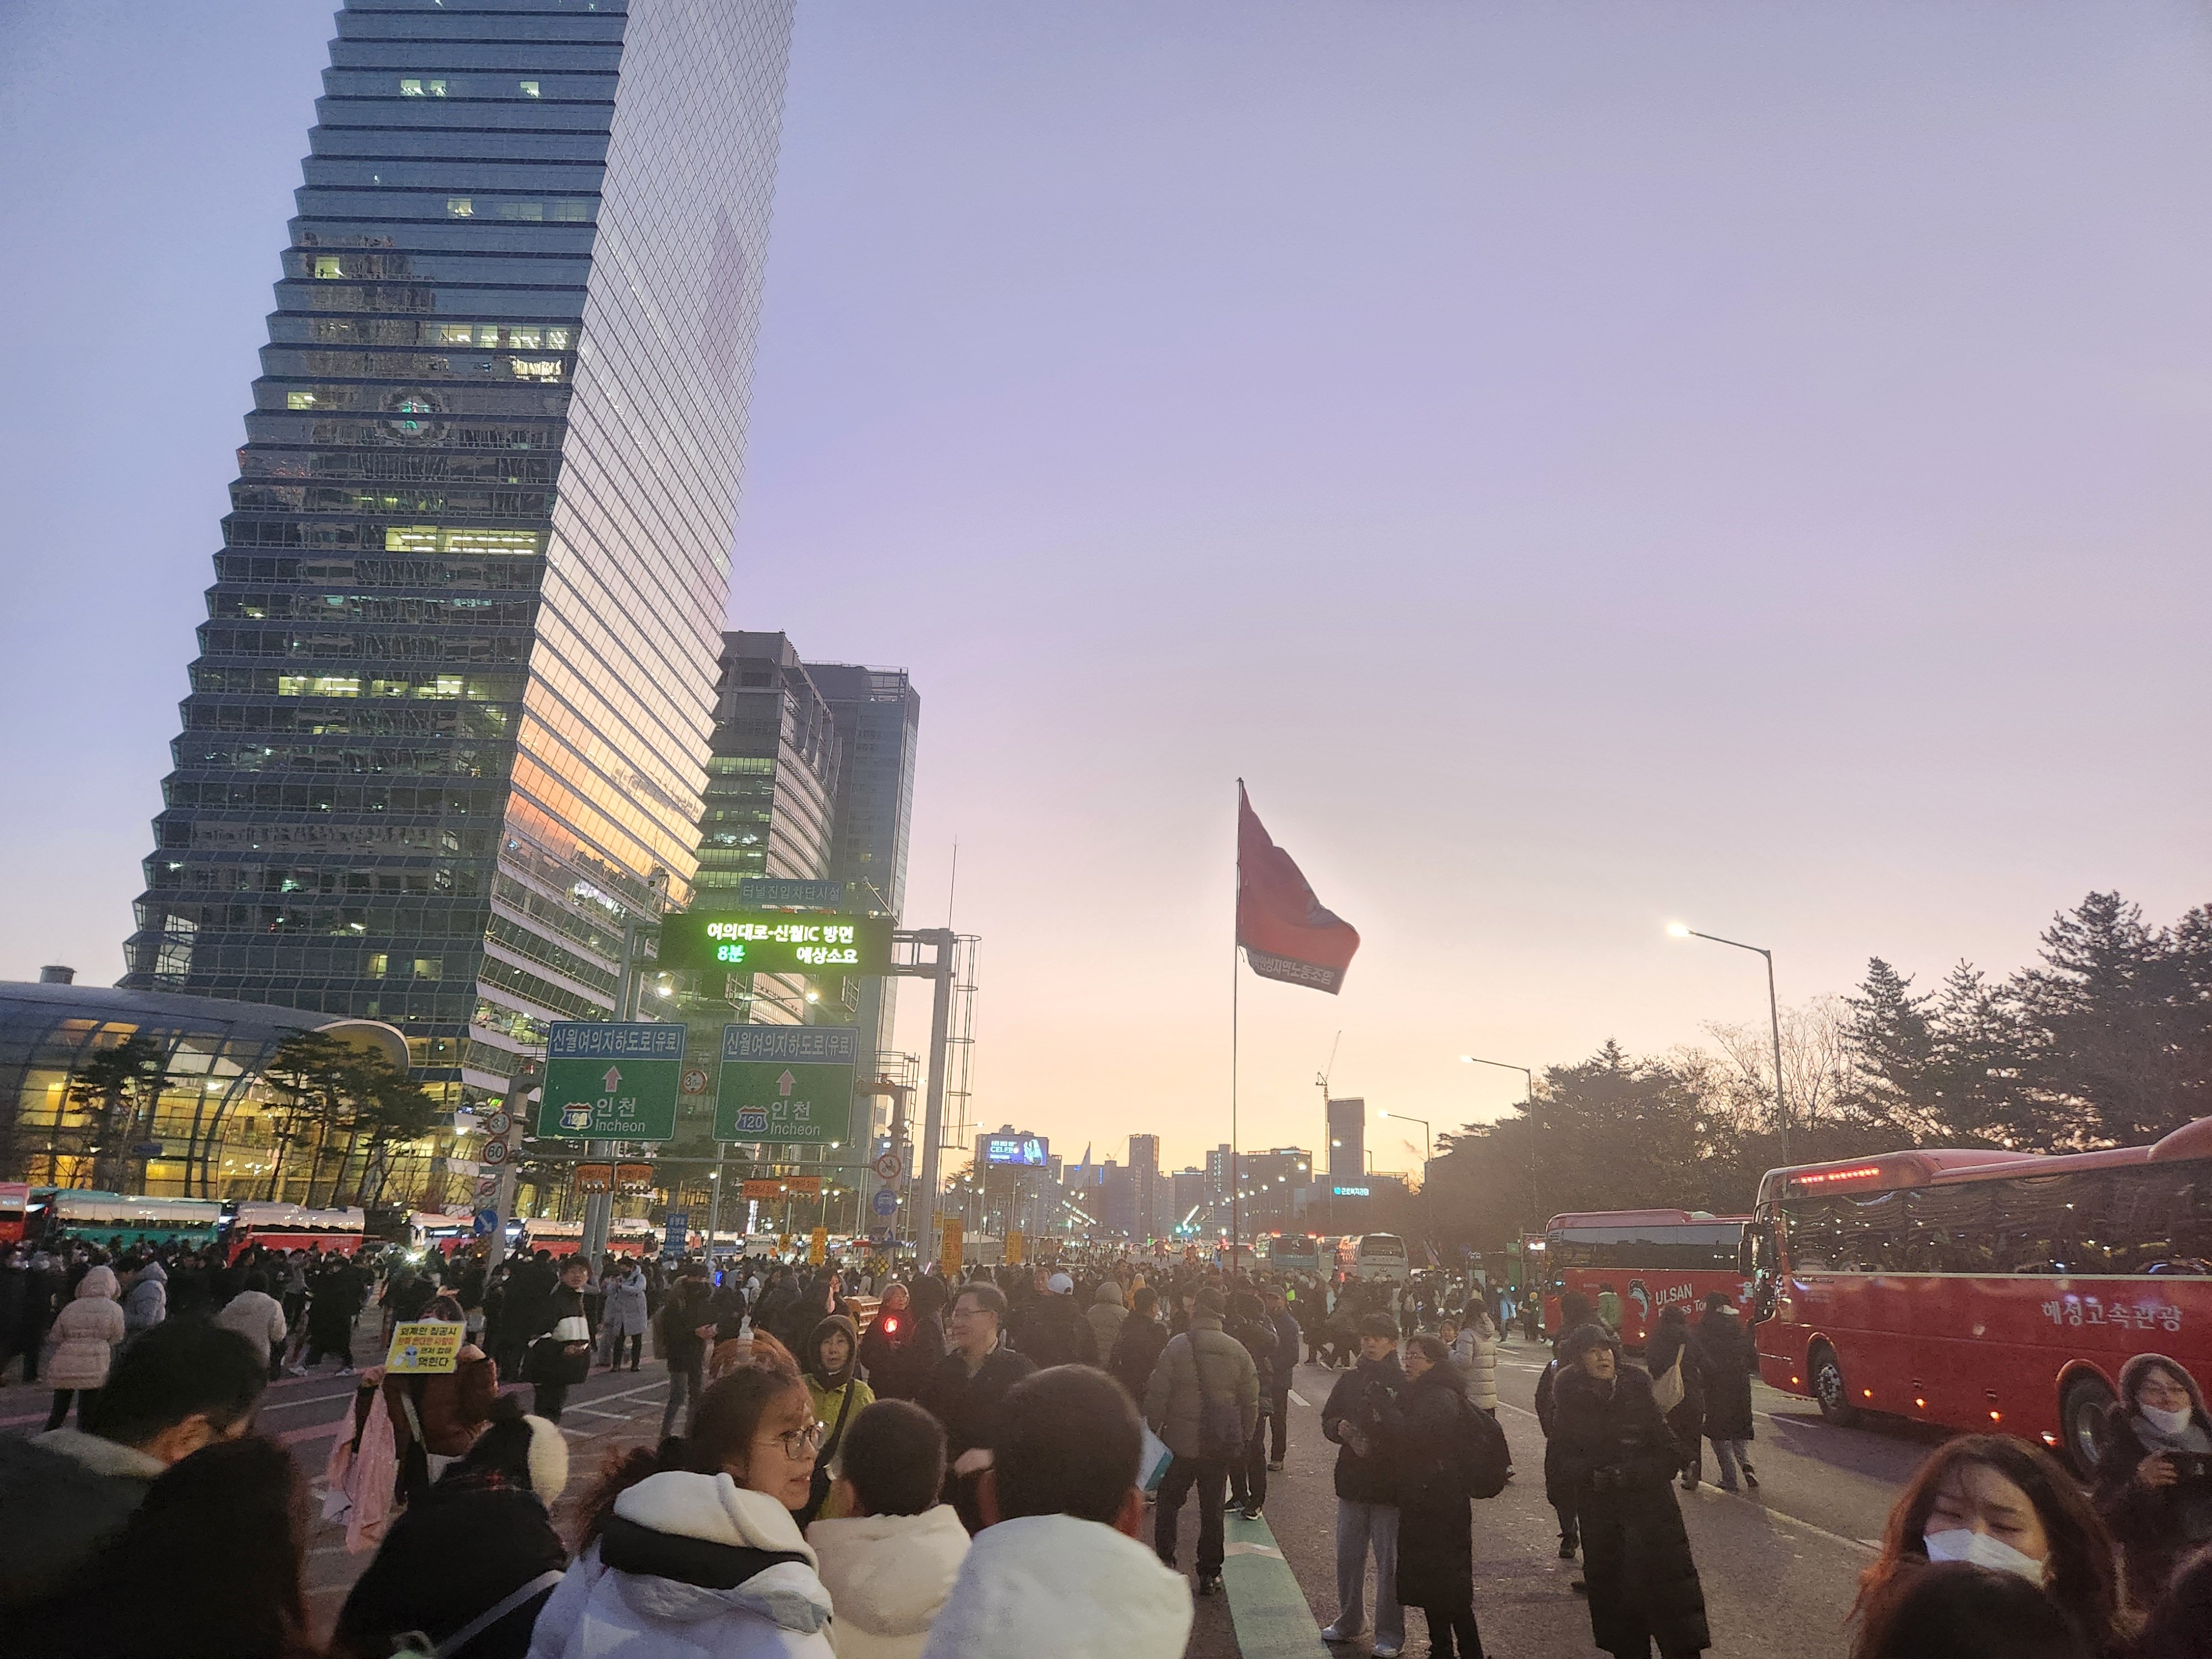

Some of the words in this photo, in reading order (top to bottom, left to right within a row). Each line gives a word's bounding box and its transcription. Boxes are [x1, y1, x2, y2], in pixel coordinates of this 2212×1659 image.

[743, 884, 840, 901] 터널진입차단시설
[823, 925, 854, 944] 방면
[717, 945, 745, 963] 8분
[796, 946, 859, 964] 예상소요
[553, 1028, 680, 1053] 신월여의지하도로(유료)
[726, 1031, 853, 1057] 신월여의지하도로(유료)
[596, 1097, 636, 1118] 인천
[771, 1100, 811, 1121] 인천
[595, 1119, 646, 1133] Incheon
[741, 1116, 763, 1129] 120
[770, 1121, 820, 1136] Incheon
[487, 1146, 503, 1158] 60
[1655, 1282, 1693, 1306] ULSAN
